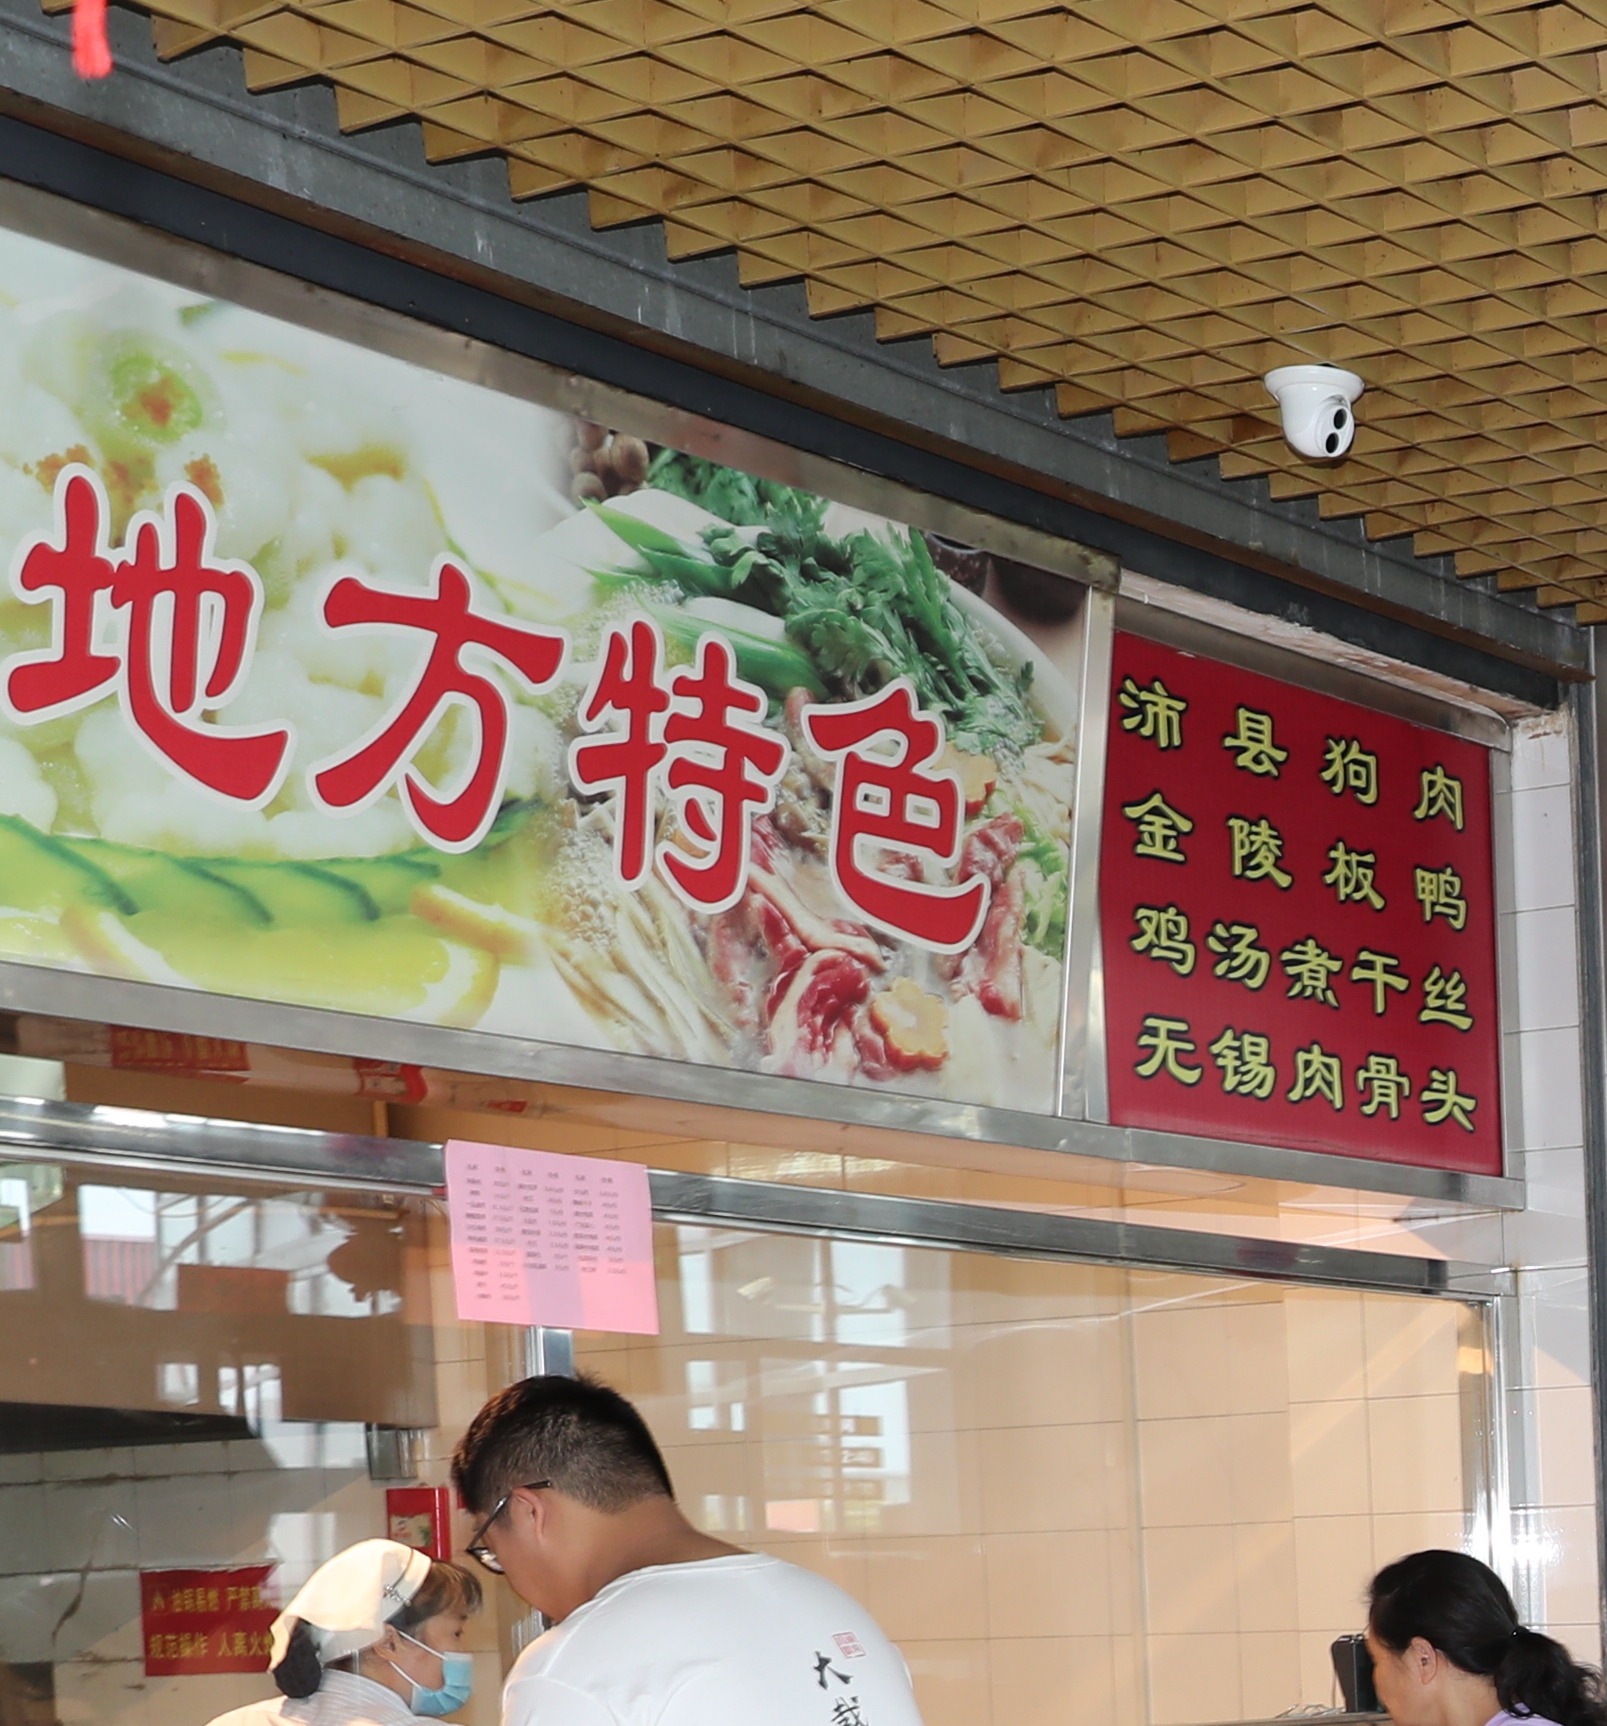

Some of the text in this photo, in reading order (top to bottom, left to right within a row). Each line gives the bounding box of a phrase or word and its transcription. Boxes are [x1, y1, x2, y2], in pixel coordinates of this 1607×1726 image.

[3, 468, 990, 952] 地方特色
[1119, 677, 1465, 832] 沛县狗肉
[1123, 792, 1469, 931] 金陵板鸭
[1131, 906, 1475, 1033] 鸡汤煮干丝
[1135, 1016, 1478, 1132] 无锡肉骨头
